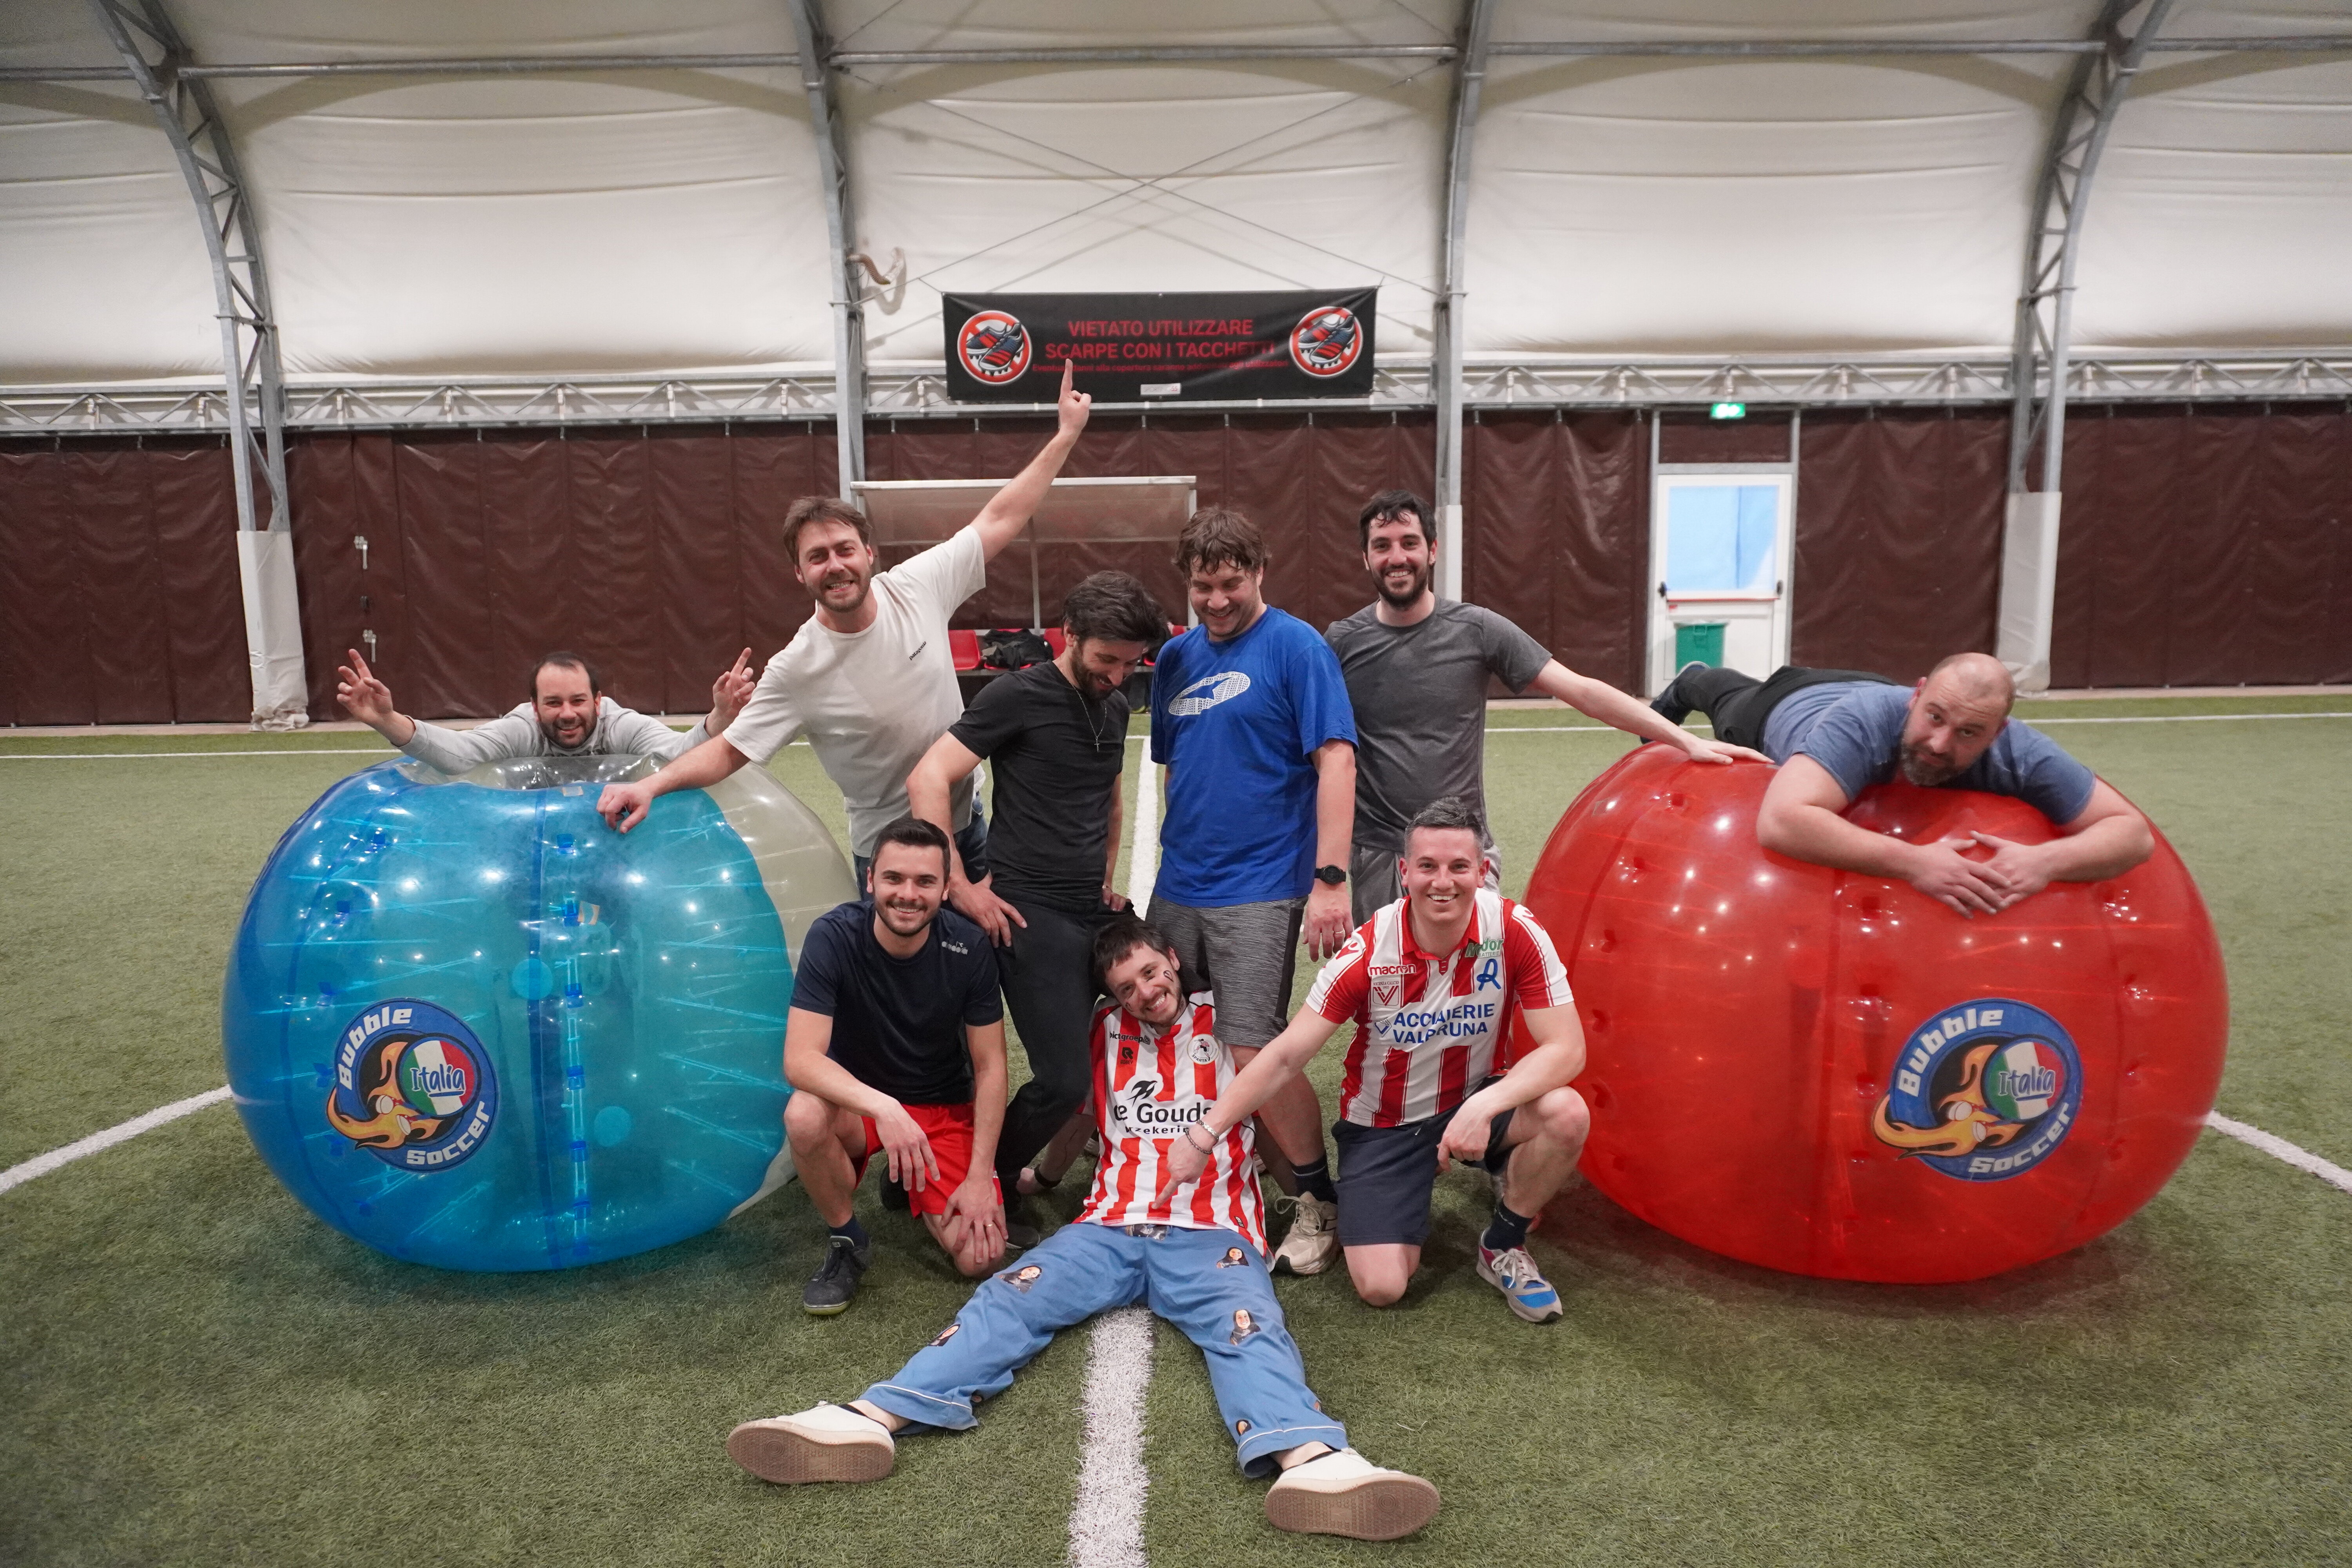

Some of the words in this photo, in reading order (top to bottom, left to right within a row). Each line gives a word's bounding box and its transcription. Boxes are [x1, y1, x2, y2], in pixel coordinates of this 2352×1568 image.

[1067, 320, 1143, 336] VIETATO
[1148, 319, 1253, 336] UTILIZZARE
[1045, 343, 1118, 359] SCARPE
[1122, 342, 1162, 358] CON
[1167, 343, 1171, 357] I
[909, 641, 926, 660] patagonia
[942, 941, 968, 955] diadora
[1369, 965, 1416, 975] macron
[1394, 1004, 1495, 1027] ACCIAIERIE
[338, 1006, 412, 1091] Bubble
[1192, 1054, 1207, 1062] SPARTA
[1898, 1008, 2004, 1097] Bubble
[412, 1063, 465, 1091] Italia
[2000, 1066, 2055, 1096] Italia
[407, 1101, 490, 1165] Soccer
[1968, 1102, 2069, 1173] Soccer
